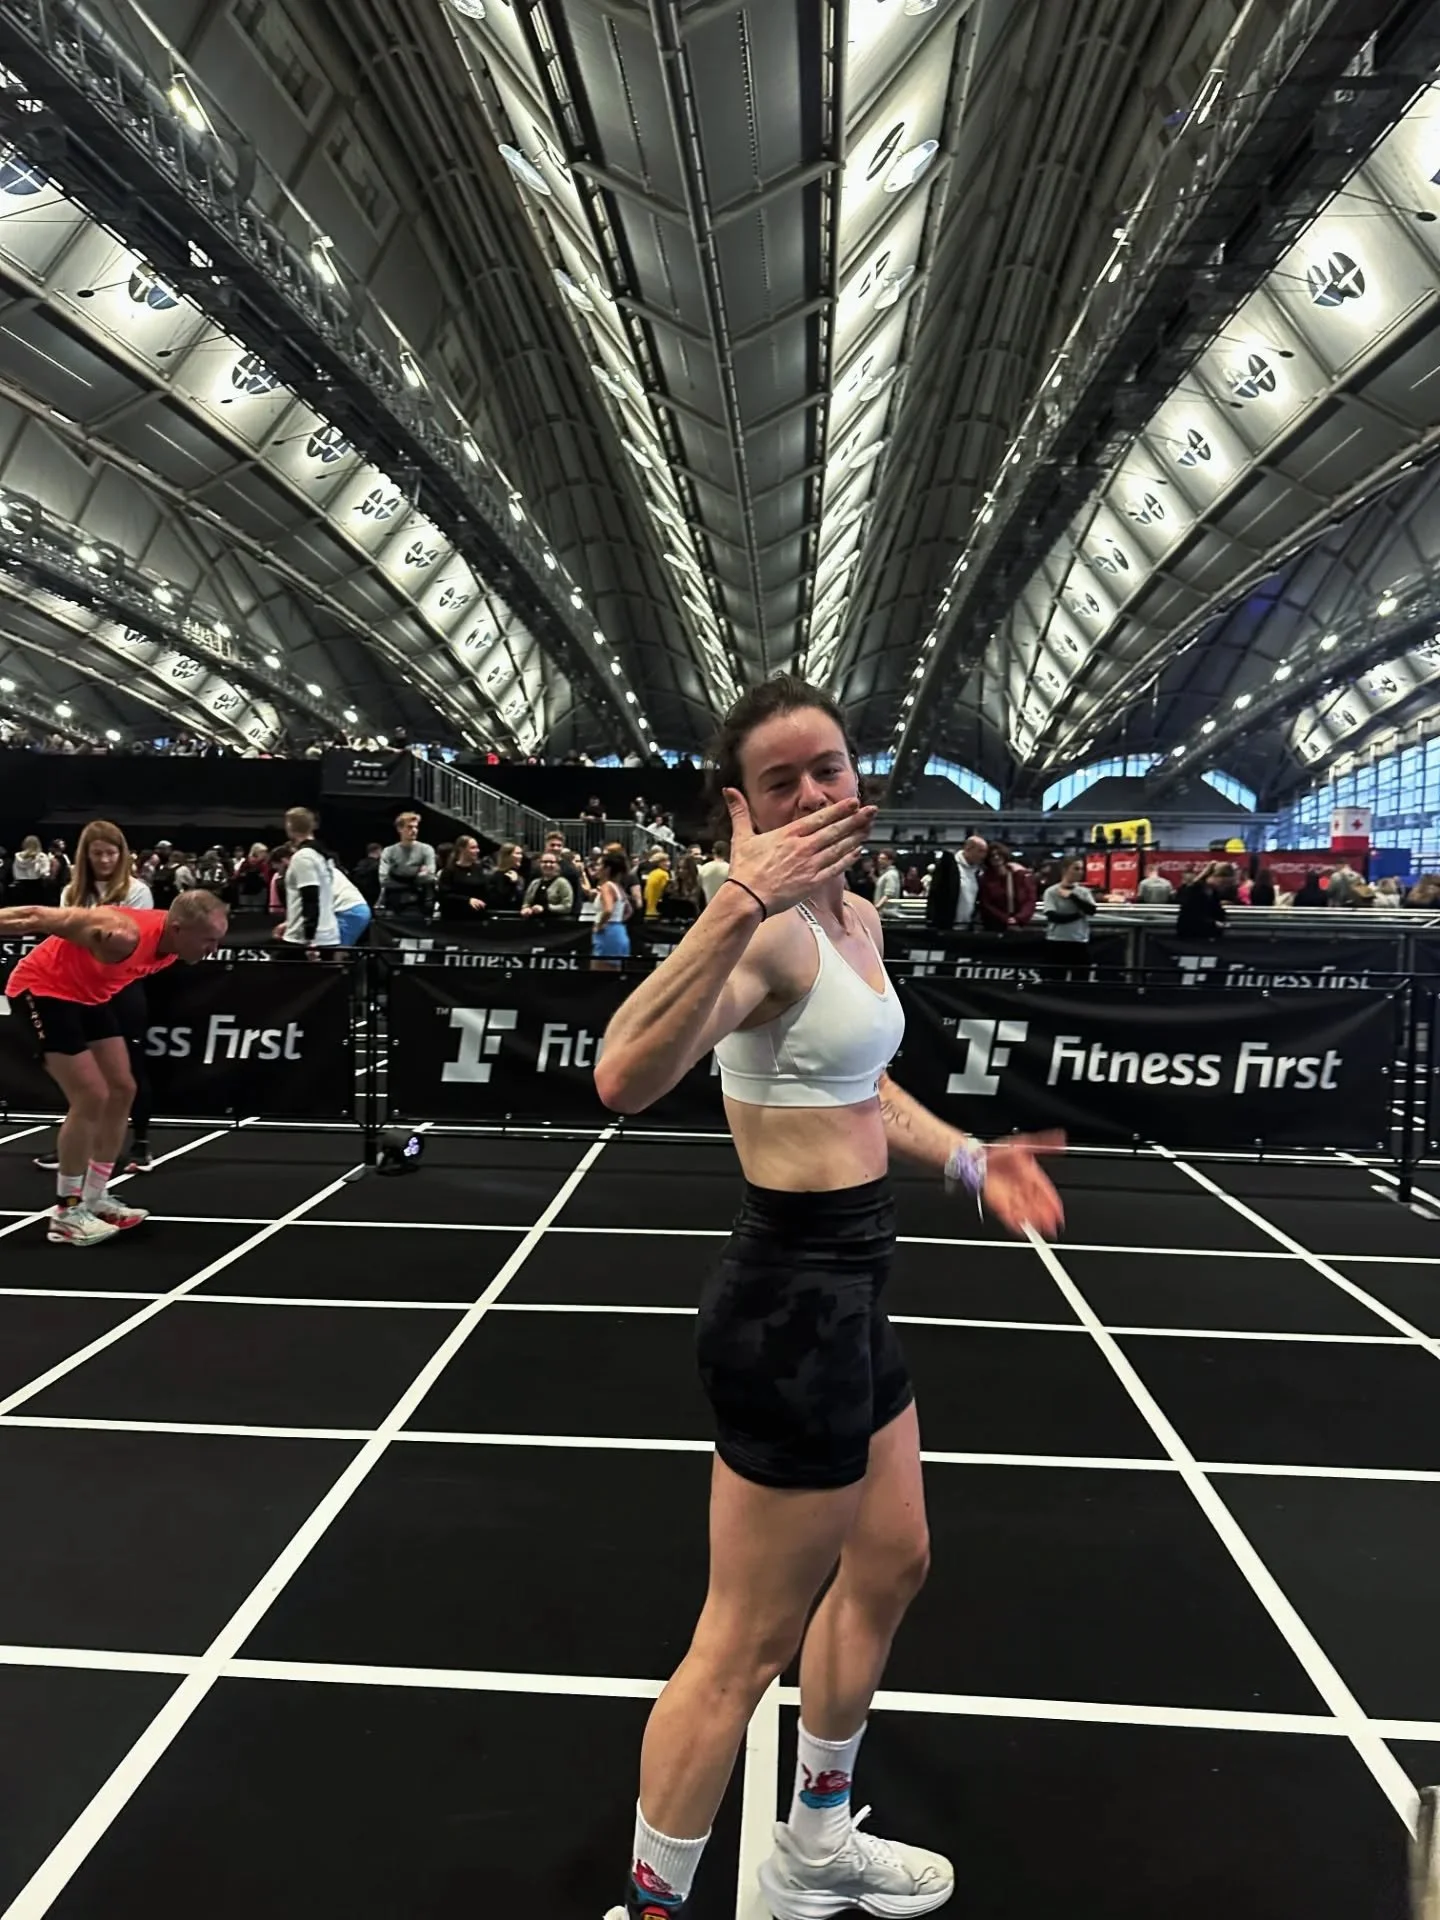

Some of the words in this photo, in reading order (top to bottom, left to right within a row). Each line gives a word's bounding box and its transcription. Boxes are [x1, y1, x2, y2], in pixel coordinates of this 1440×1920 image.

[203, 1013, 305, 1065] First
[1047, 1035, 1222, 1088] Fitness
[1232, 1041, 1343, 1095] First
